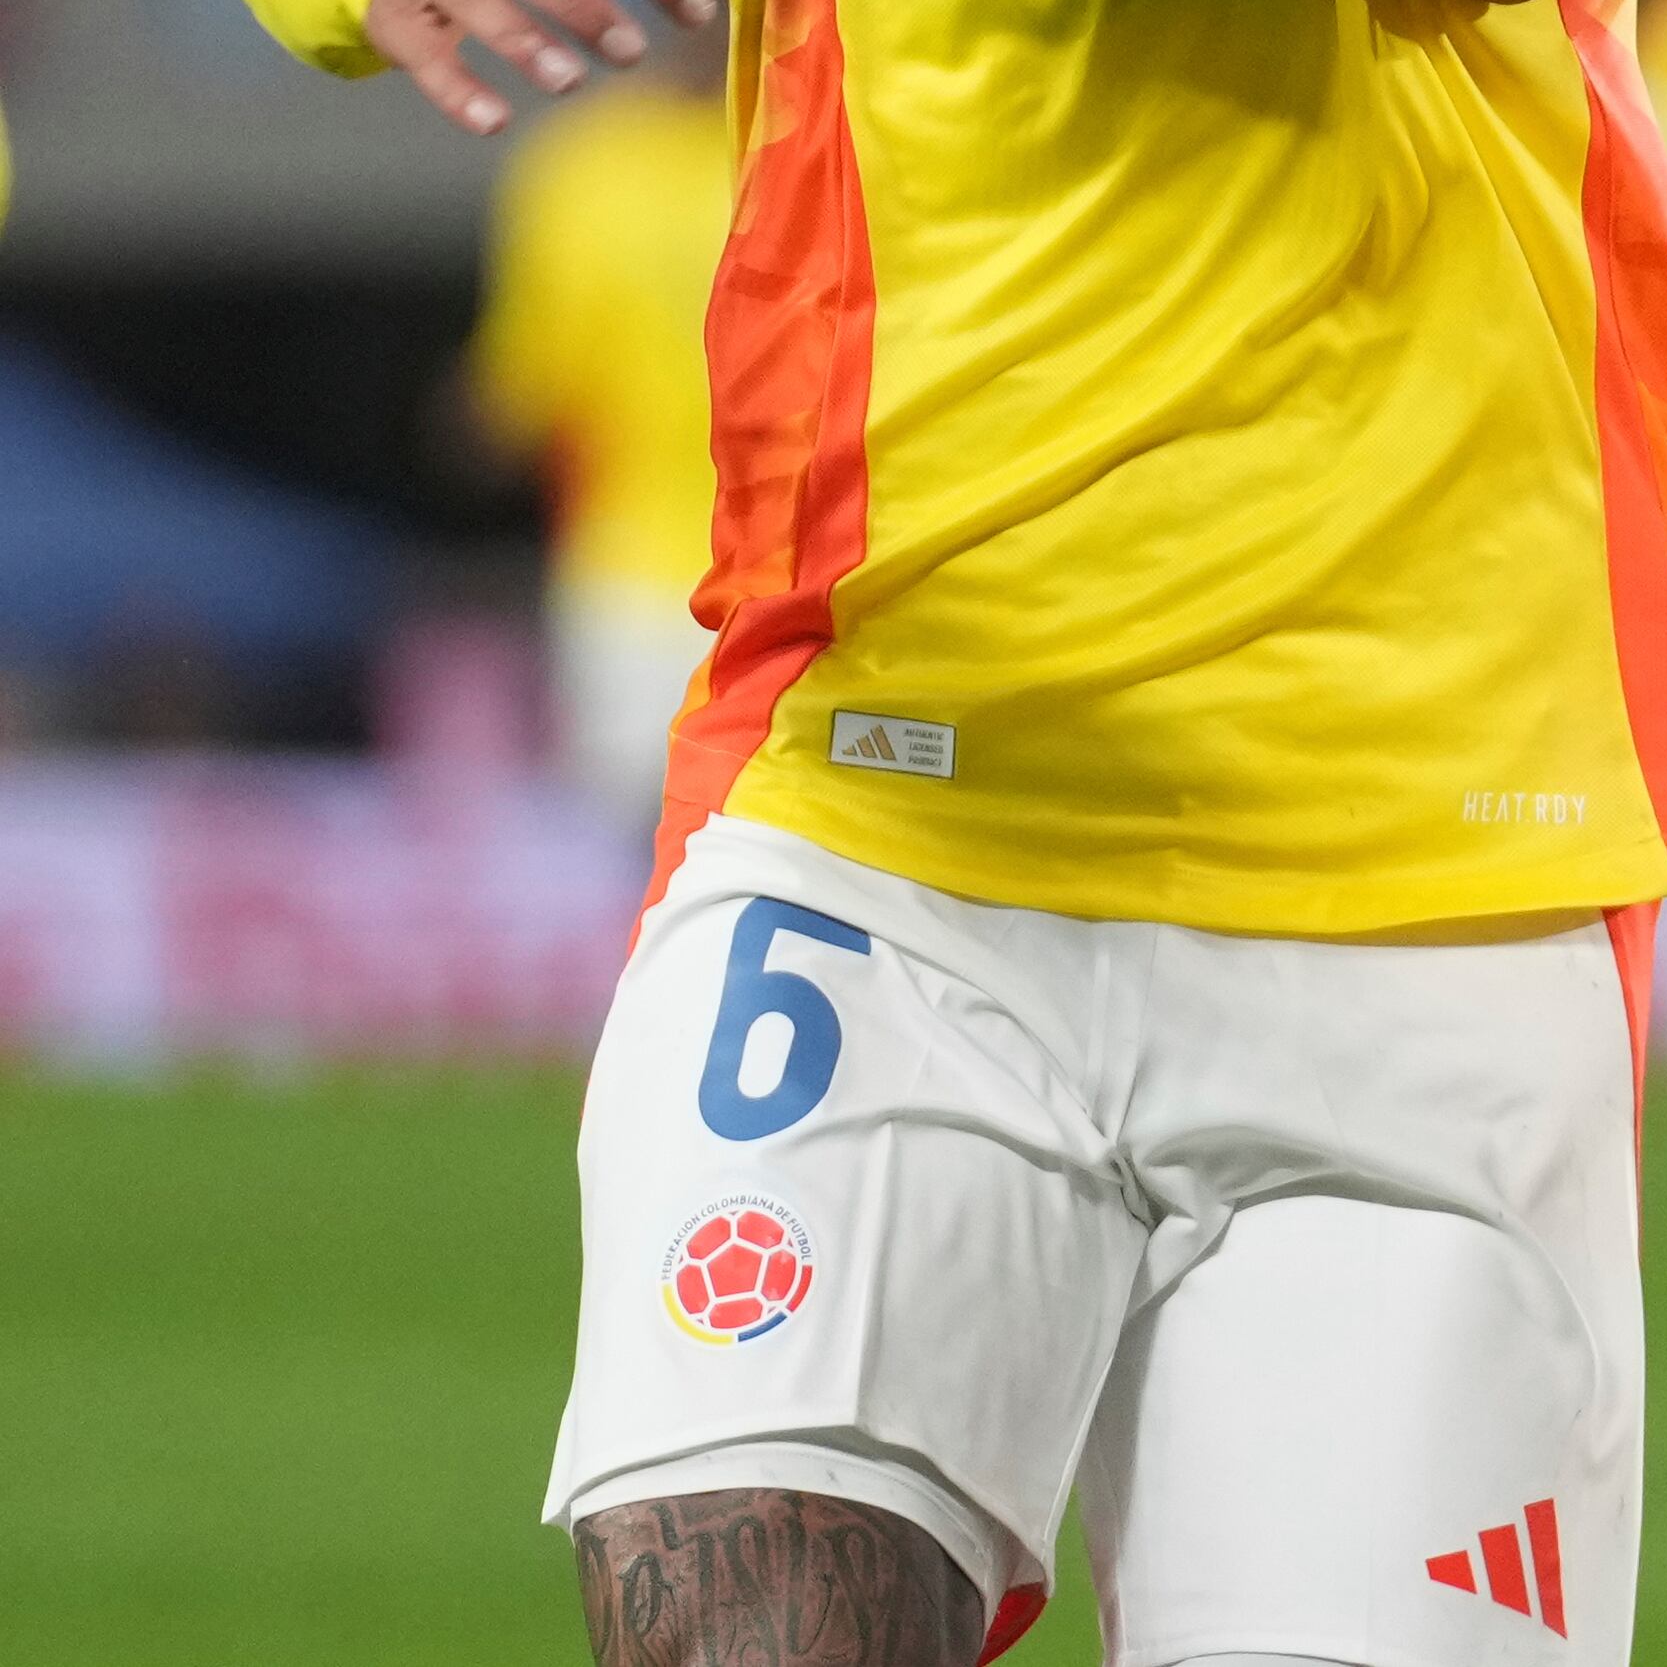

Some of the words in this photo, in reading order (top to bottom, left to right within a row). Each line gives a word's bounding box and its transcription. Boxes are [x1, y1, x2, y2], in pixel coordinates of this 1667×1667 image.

[698, 895, 872, 1142] 6
[700, 1195, 775, 1219] COLOMBIANA
[774, 1206, 790, 1222] DE
